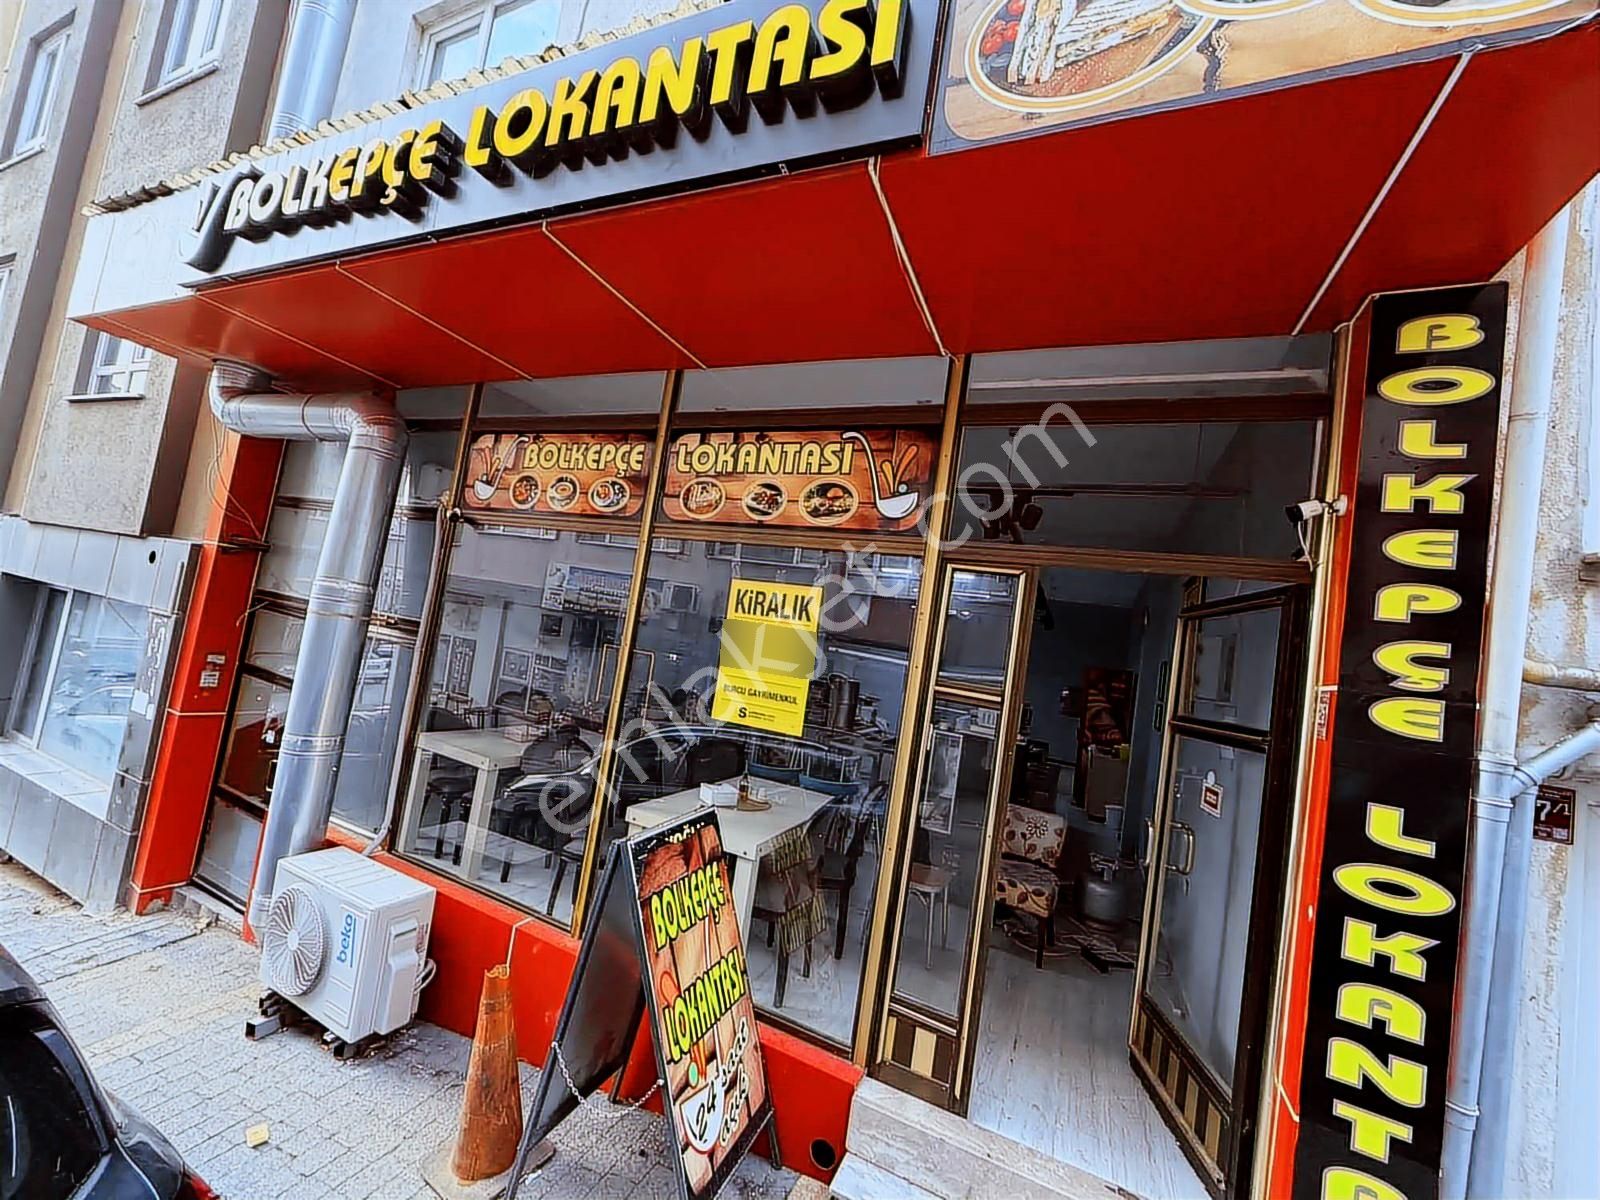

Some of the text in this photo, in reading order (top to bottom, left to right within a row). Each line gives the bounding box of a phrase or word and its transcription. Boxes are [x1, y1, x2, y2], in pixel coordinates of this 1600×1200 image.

[224, 0, 901, 230] BOLKEPÇE LOKANTASI
[523, 442, 855, 478] BOLKEPÇE LOKANTASI
[336, 913, 353, 963] beko
[651, 861, 726, 949] BOLKEPÇE
[663, 949, 745, 1062] LOKANTASI
